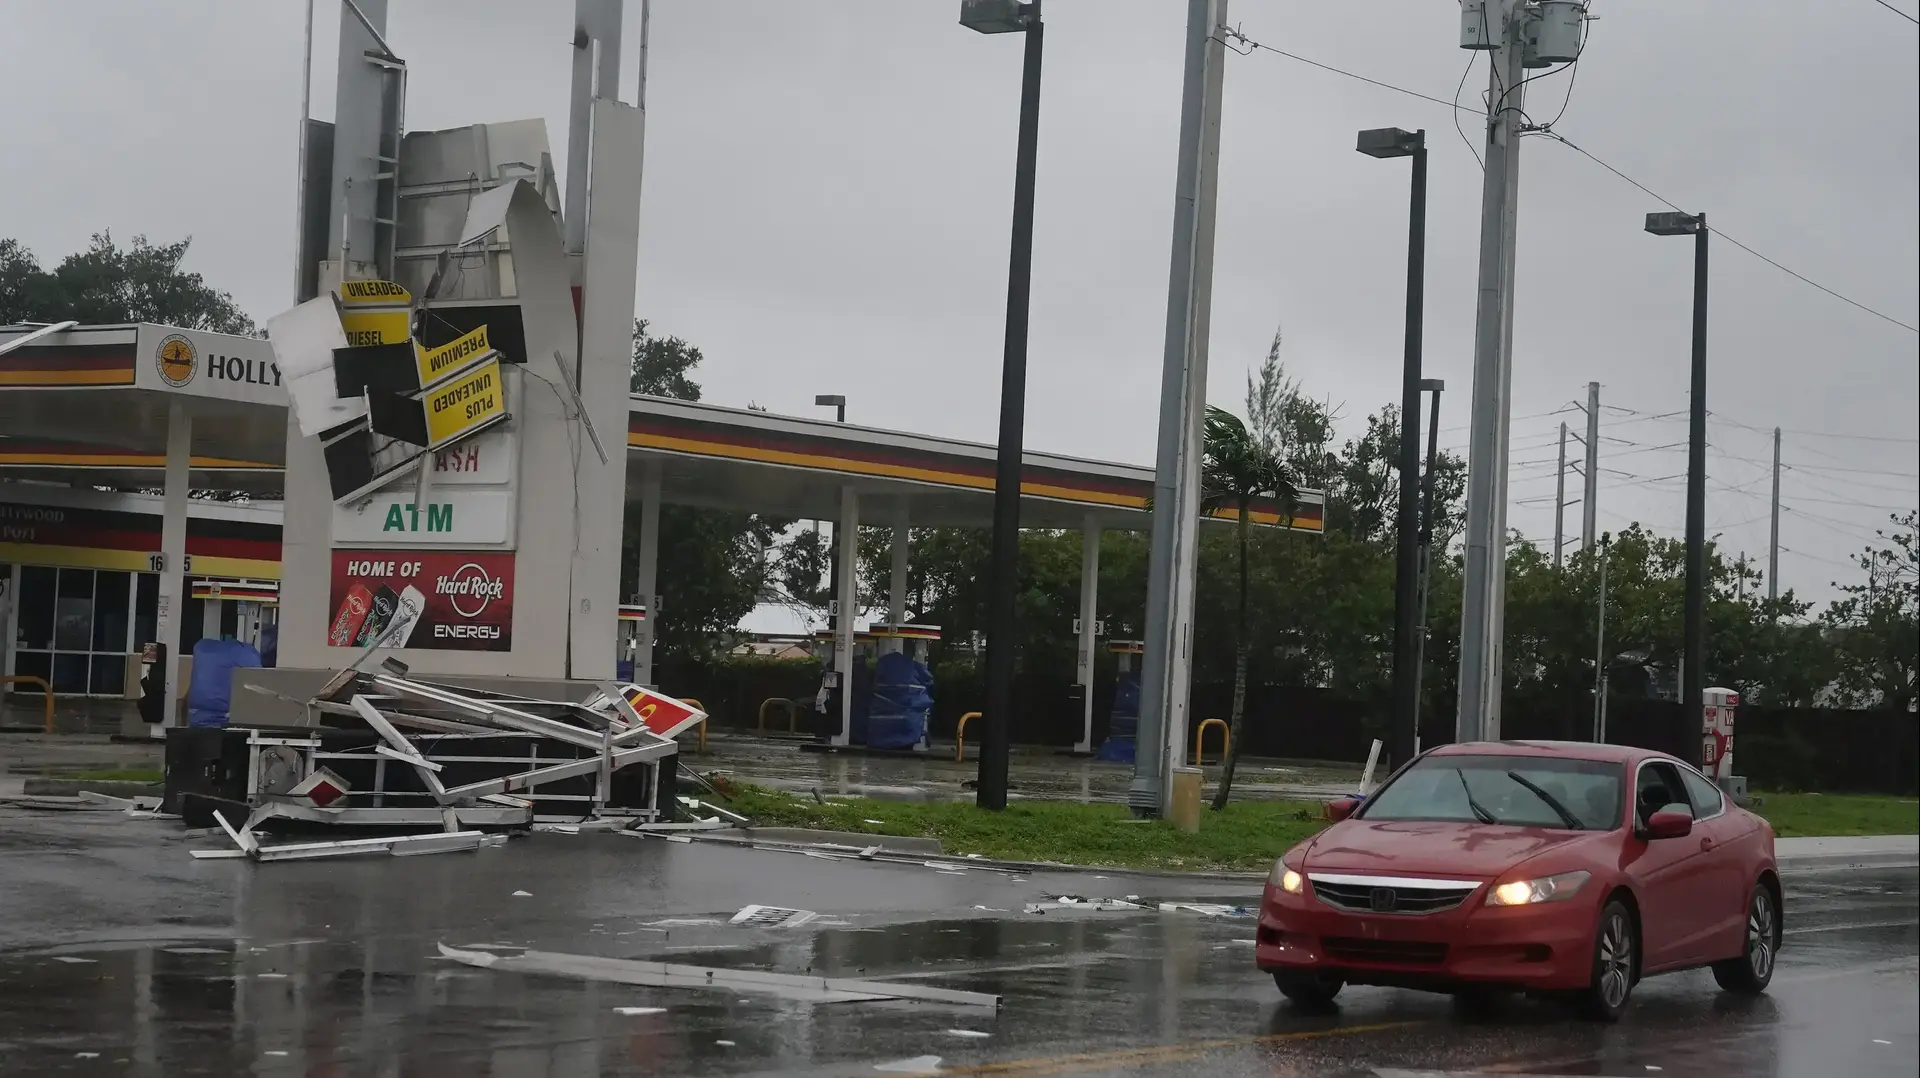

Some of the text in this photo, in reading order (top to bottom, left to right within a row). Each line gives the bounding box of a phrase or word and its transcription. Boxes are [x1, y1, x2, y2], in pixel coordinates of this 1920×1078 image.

[347, 281, 403, 297] UNLEADED
[348, 331, 384, 345] DIESEL
[430, 333, 486, 372] PREMIUM
[207, 353, 281, 386] HOLLY
[433, 373, 491, 413] UNLEADED
[466, 394, 494, 419] PLUS
[383, 503, 453, 532] ATM
[150, 555, 163, 572] 16
[347, 561, 422, 577] HOME OF
[436, 576, 503, 599] Hard Rock
[832, 601, 838, 614] 8
[434, 624, 500, 639] ENERGY
[1095, 622, 1100, 633] 3
